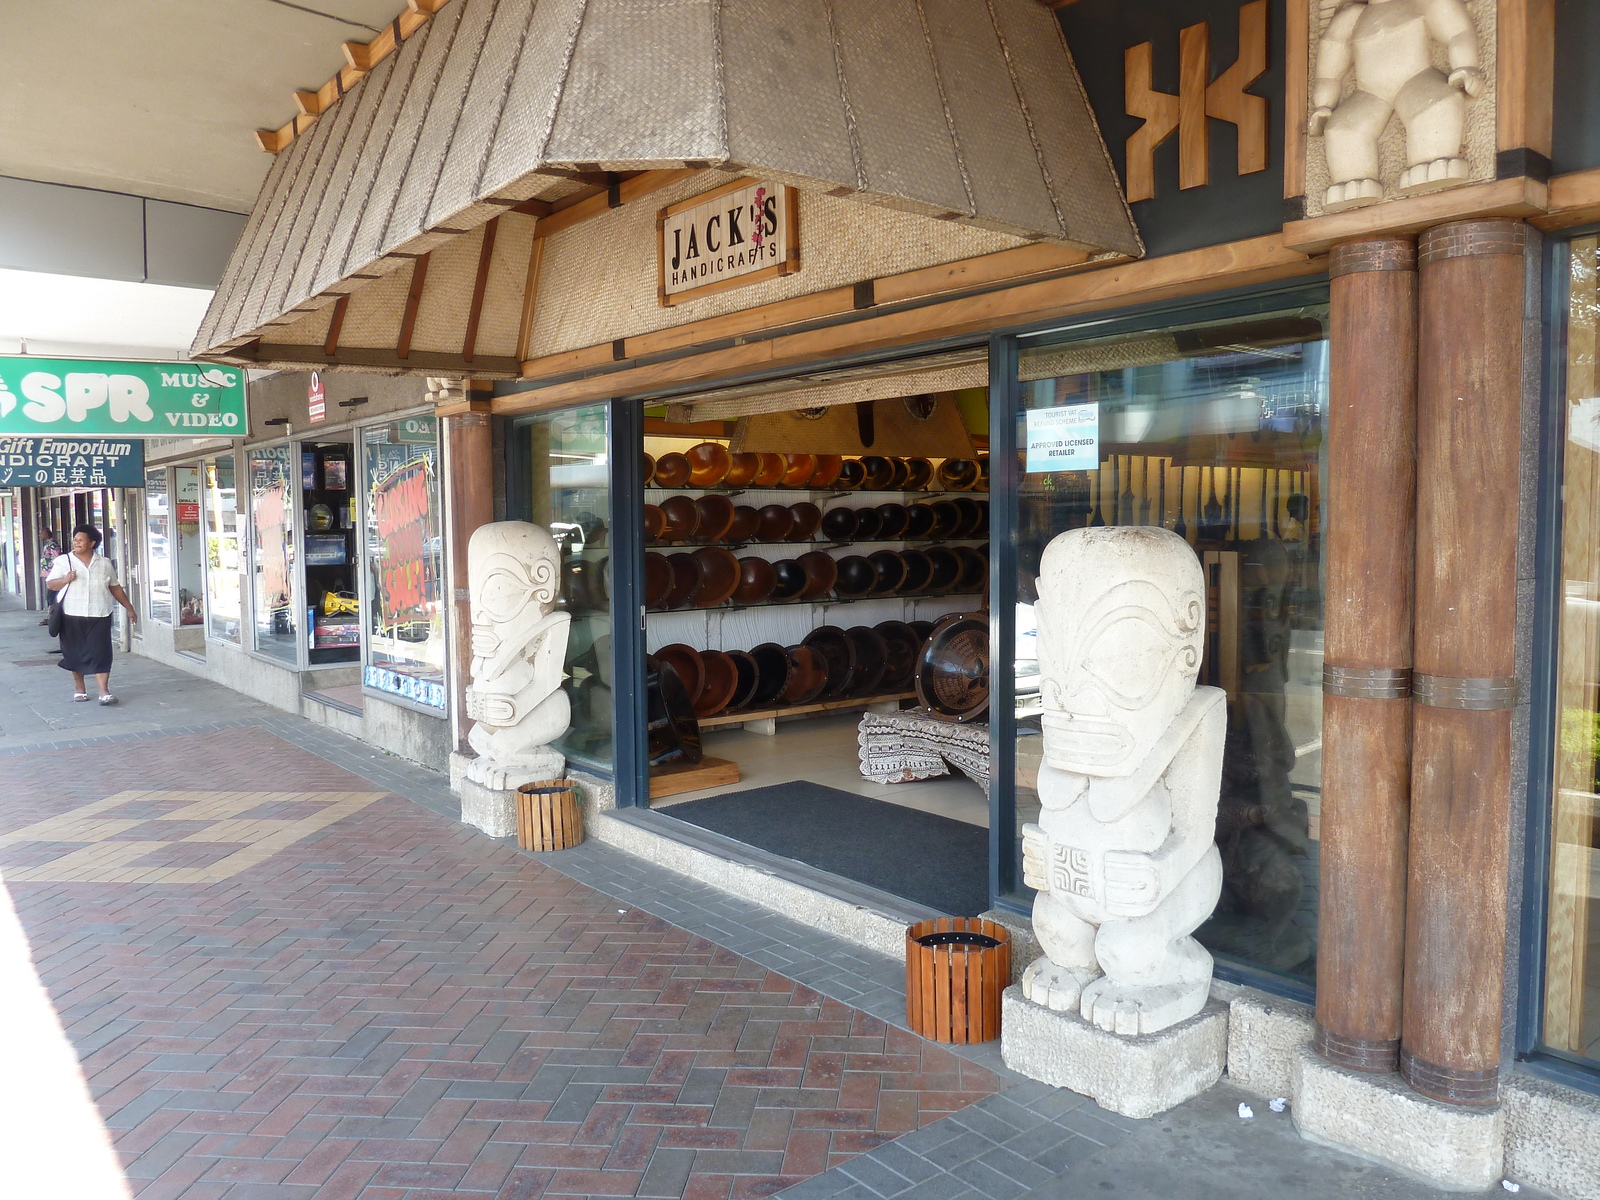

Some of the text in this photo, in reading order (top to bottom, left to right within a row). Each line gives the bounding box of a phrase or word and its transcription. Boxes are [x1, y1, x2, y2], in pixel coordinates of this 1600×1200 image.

[671, 195, 778, 270] JACK'S
[672, 242, 777, 286] HANDICRAFTS
[161, 371, 237, 388] MUSC
[21, 371, 155, 423] SPR
[191, 393, 210, 408] &
[165, 412, 239, 427] VIDEO
[1045, 410, 1067, 419] TOURIST
[1056, 418, 1077, 426] SCHEME
[0, 437, 34, 454] Gift
[39, 438, 132, 457] Emporium
[1031, 438, 1094, 449] APPROVED LICENSED
[1048, 448, 1075, 457] RETAILER
[1, 467, 107, 485] ジーの民芸品
[377, 468, 428, 539] CLOSING
[384, 557, 428, 615] SALE!
